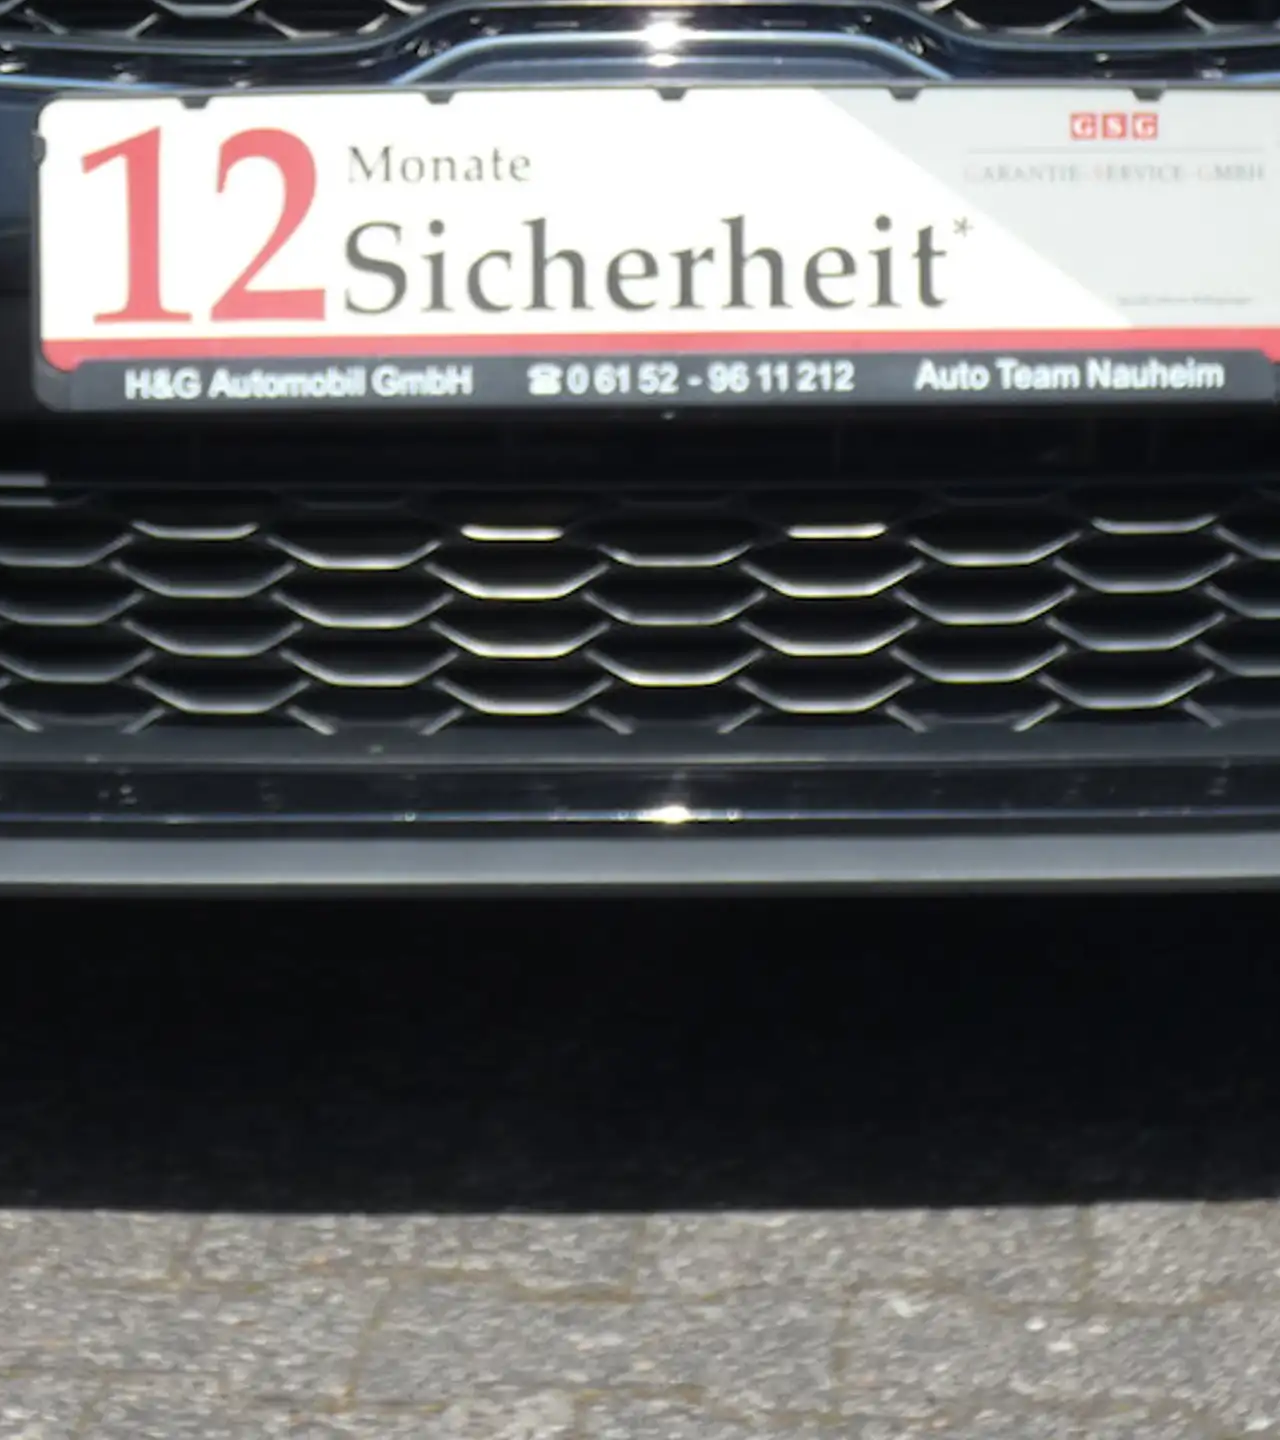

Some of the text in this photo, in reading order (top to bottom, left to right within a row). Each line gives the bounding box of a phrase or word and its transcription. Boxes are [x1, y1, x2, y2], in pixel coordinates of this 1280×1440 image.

[347, 143, 532, 184] Monate
[81, 125, 326, 324] 12
[124, 363, 473, 400] H&G Automobil GmbH
[914, 357, 1226, 390] Auto Team Nauheim
